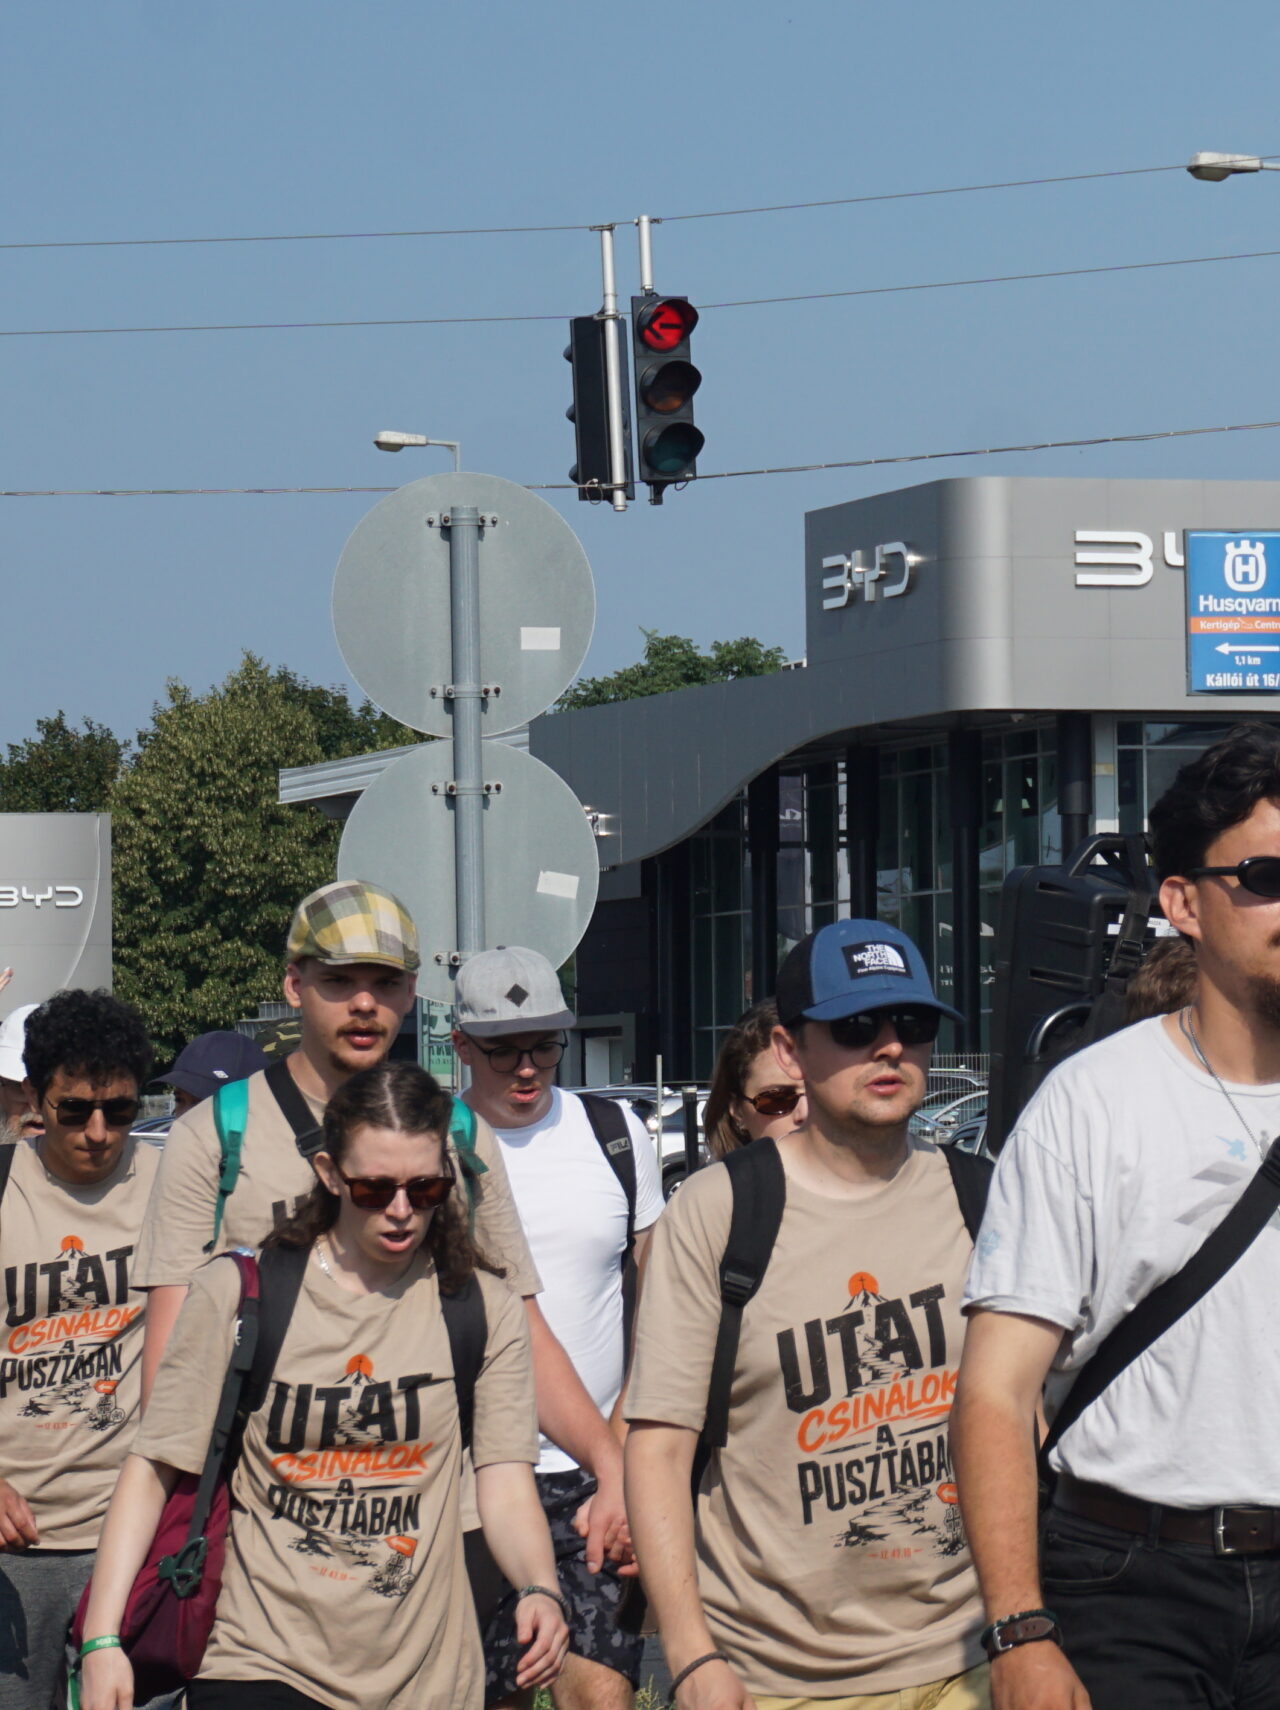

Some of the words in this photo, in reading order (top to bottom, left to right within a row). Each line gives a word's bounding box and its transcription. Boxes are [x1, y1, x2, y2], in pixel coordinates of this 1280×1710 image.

[822, 541, 910, 610] BYD
[1200, 620, 1240, 631] Kertigép
[1206, 673, 1243, 687] Kállói
[1246, 672, 1260, 687] út
[1235, 655, 1246, 667] 1,1
[1249, 655, 1261, 665] km
[0, 886, 83, 906] BYD
[5, 1245, 134, 1327] UTAT
[8, 1305, 141, 1354] CSINÁLOK
[59, 1339, 76, 1353] A
[776, 1284, 946, 1414] UTAT
[0, 1343, 123, 1398] PUSZTÁBAN
[266, 1373, 433, 1454] UTAT
[875, 1424, 896, 1451] A
[270, 1442, 433, 1482] CSINÁLOK
[797, 1430, 953, 1526] PUSZTÁBA
[335, 1478, 355, 1498] A
